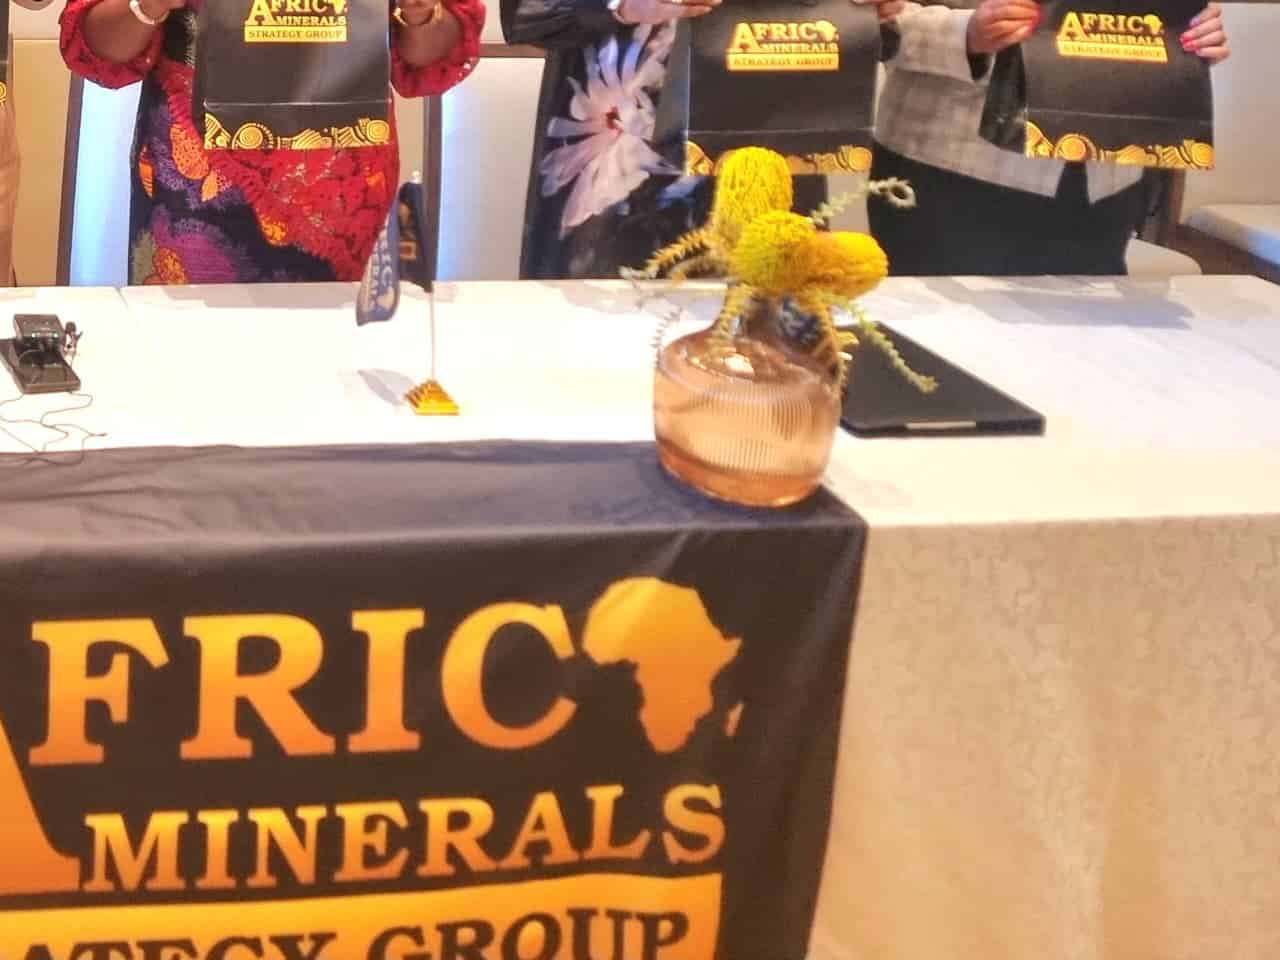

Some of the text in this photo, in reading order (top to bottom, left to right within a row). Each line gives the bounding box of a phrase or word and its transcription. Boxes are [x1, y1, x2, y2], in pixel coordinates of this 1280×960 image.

[276, 16, 347, 26] MINERALS
[759, 43, 839, 53] MINERALS
[82, 783, 726, 892] MINERALS
